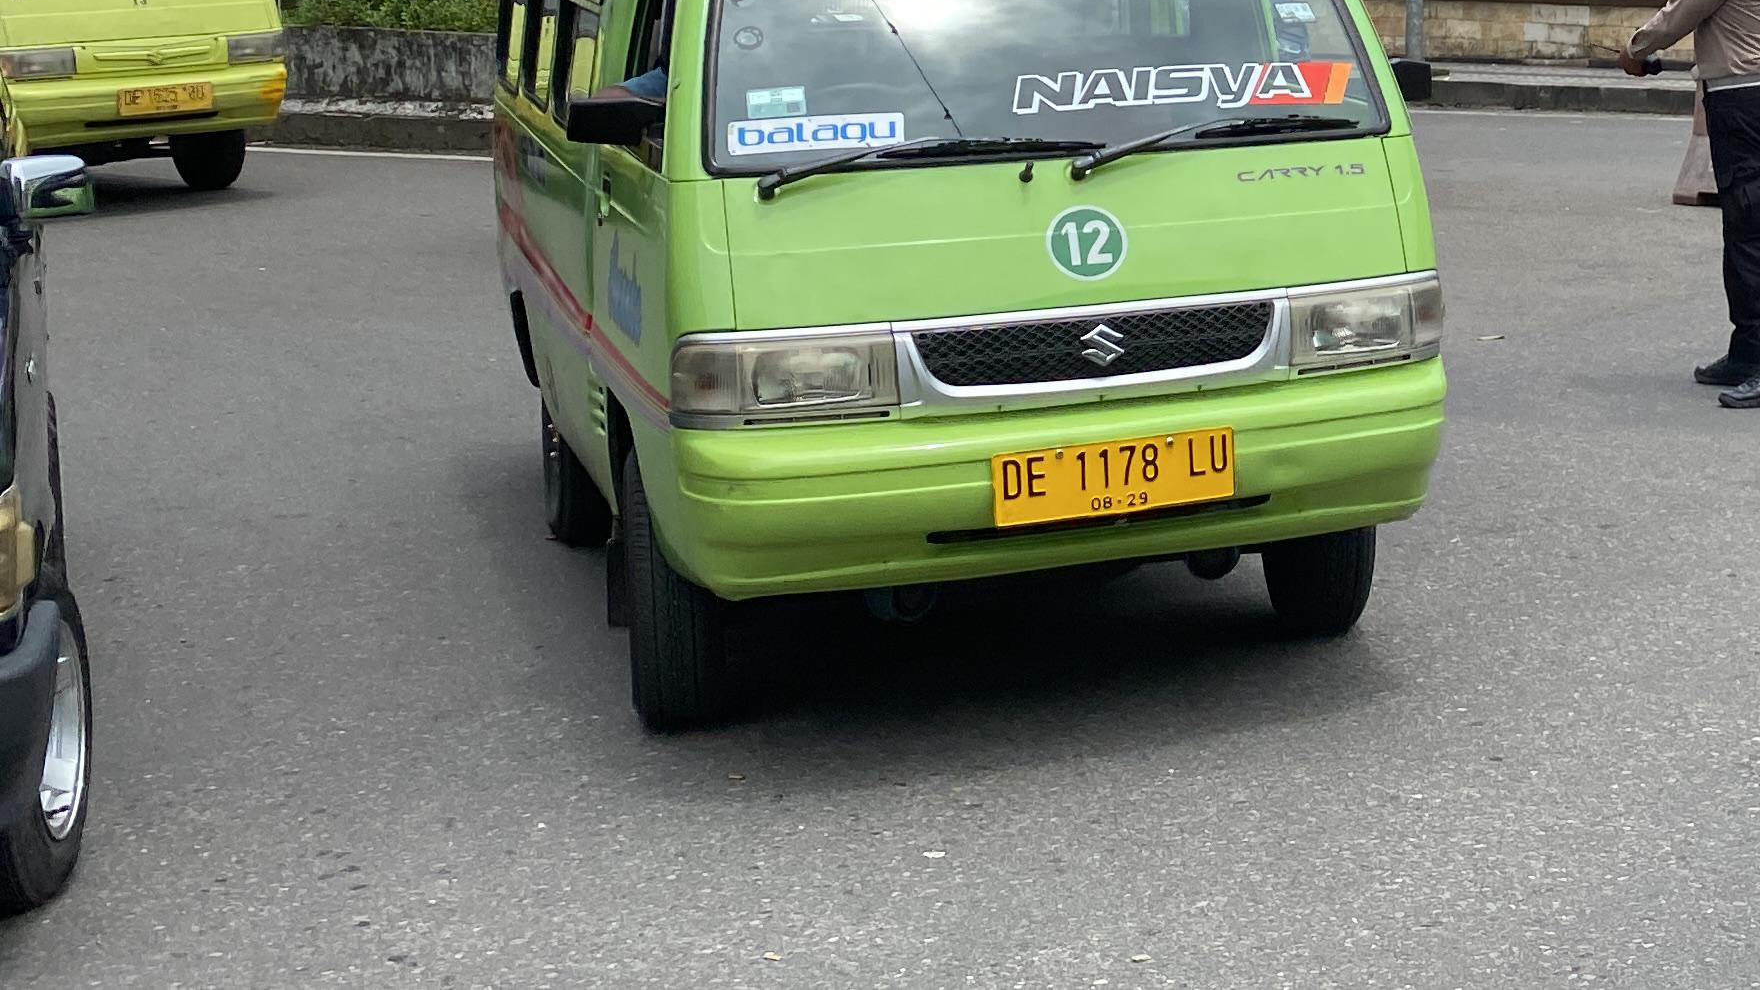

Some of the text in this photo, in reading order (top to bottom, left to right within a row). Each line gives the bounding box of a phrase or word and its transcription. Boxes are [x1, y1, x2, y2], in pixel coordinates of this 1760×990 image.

[1013, 62, 1312, 115] NAISYA
[1237, 163, 1366, 182] CARRY 1.5
[1061, 219, 1113, 266] 12
[1002, 433, 1228, 501] DE 1178 LU
